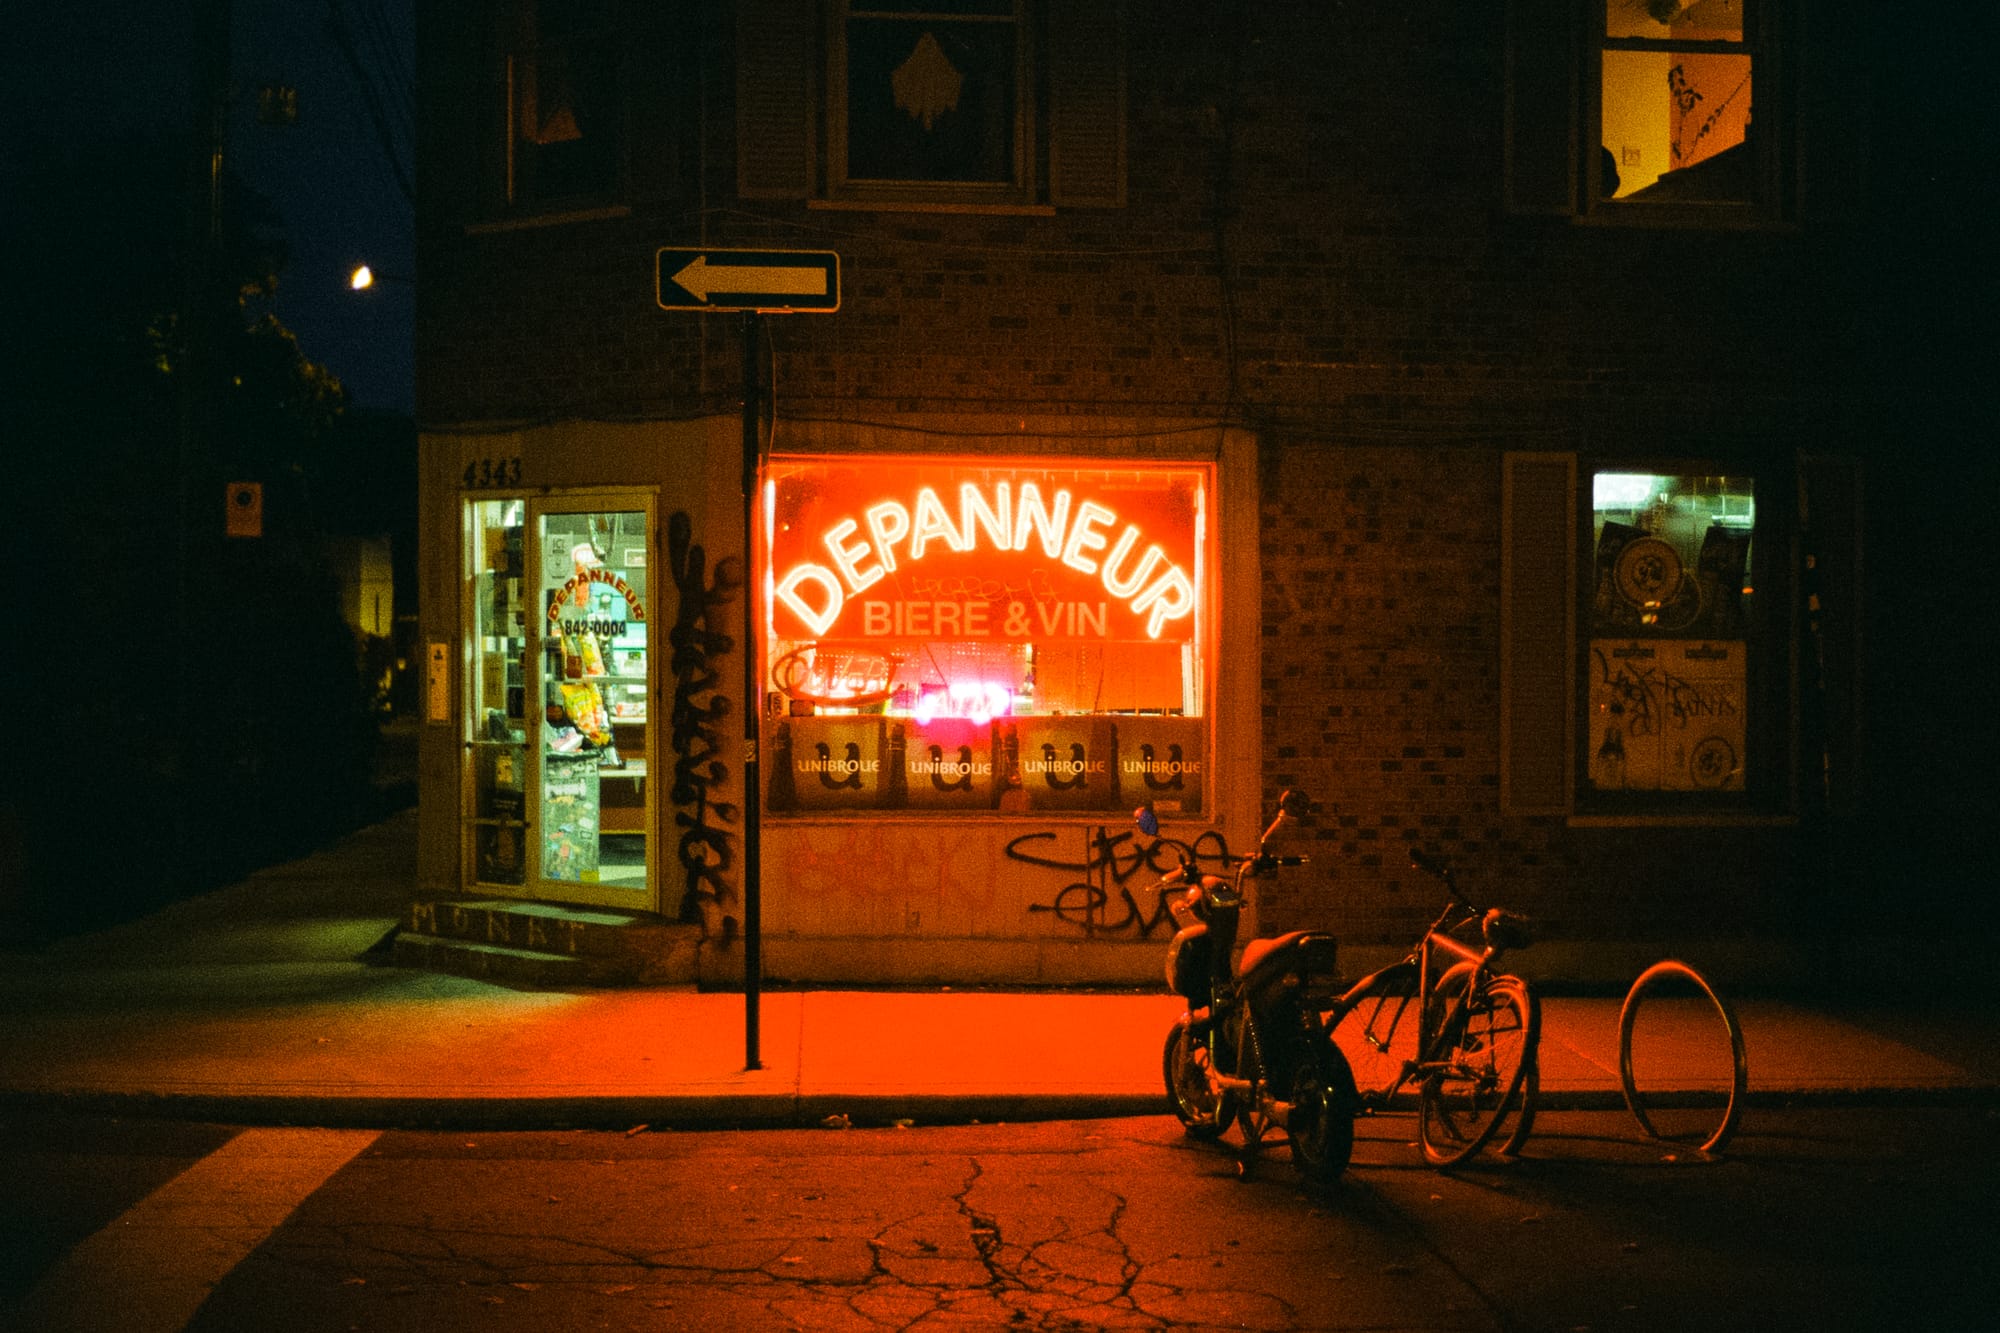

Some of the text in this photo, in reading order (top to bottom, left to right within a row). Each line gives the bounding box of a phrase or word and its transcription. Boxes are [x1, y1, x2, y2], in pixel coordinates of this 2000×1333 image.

[464, 458, 522, 488] 4343
[776, 483, 1194, 639] DEPANNEUR
[548, 569, 645, 622] DEPANNEUR
[564, 619, 627, 637] 842-0004
[863, 600, 1108, 637] BIERE & VIN
